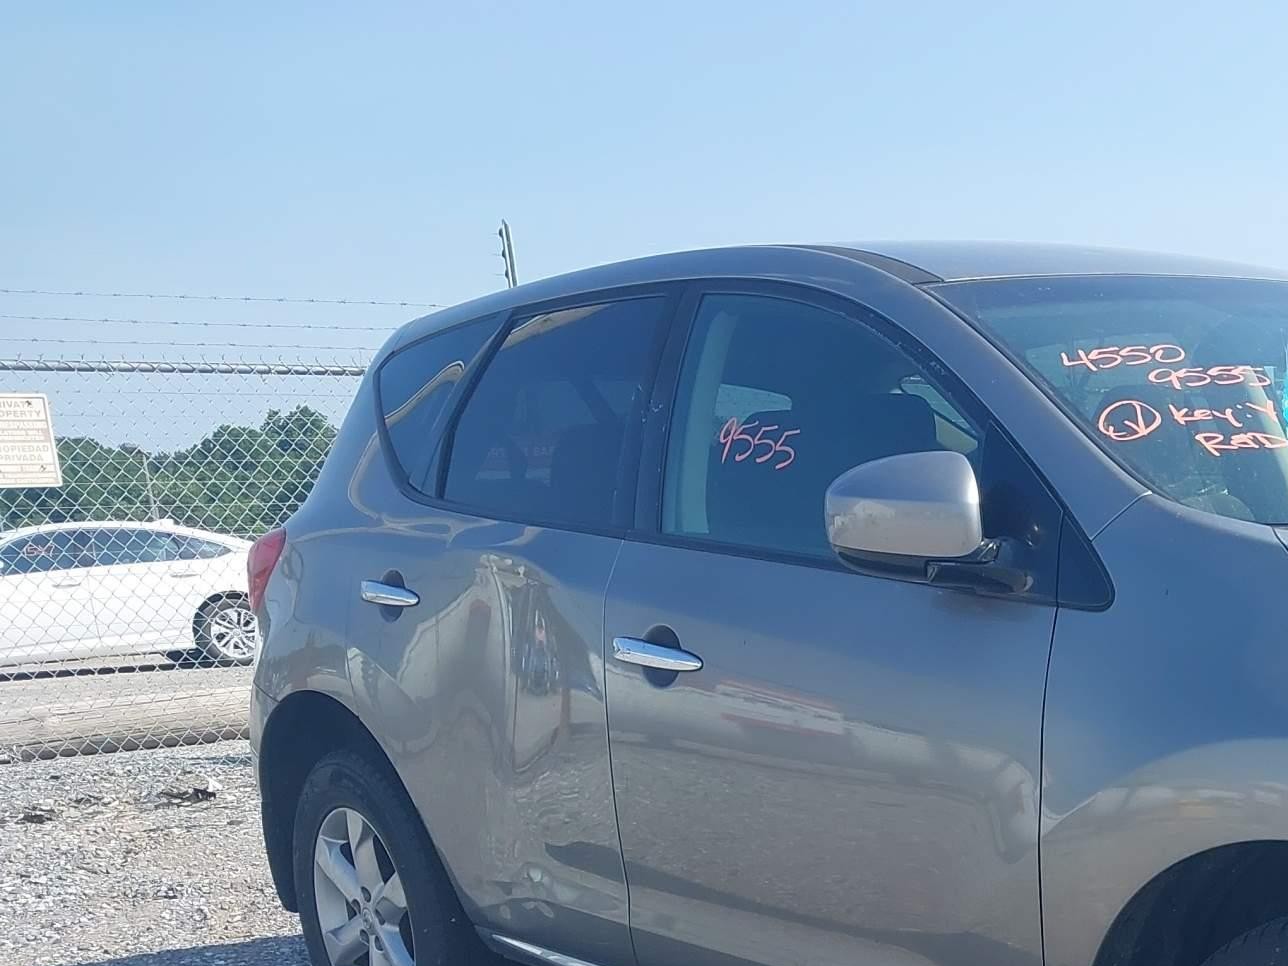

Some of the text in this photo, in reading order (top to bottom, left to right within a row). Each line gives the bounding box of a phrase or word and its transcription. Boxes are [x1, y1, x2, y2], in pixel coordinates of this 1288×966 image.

[1060, 344, 1185, 372] 4550
[1148, 365, 1272, 390] 9555
[720, 417, 801, 470] 9555
